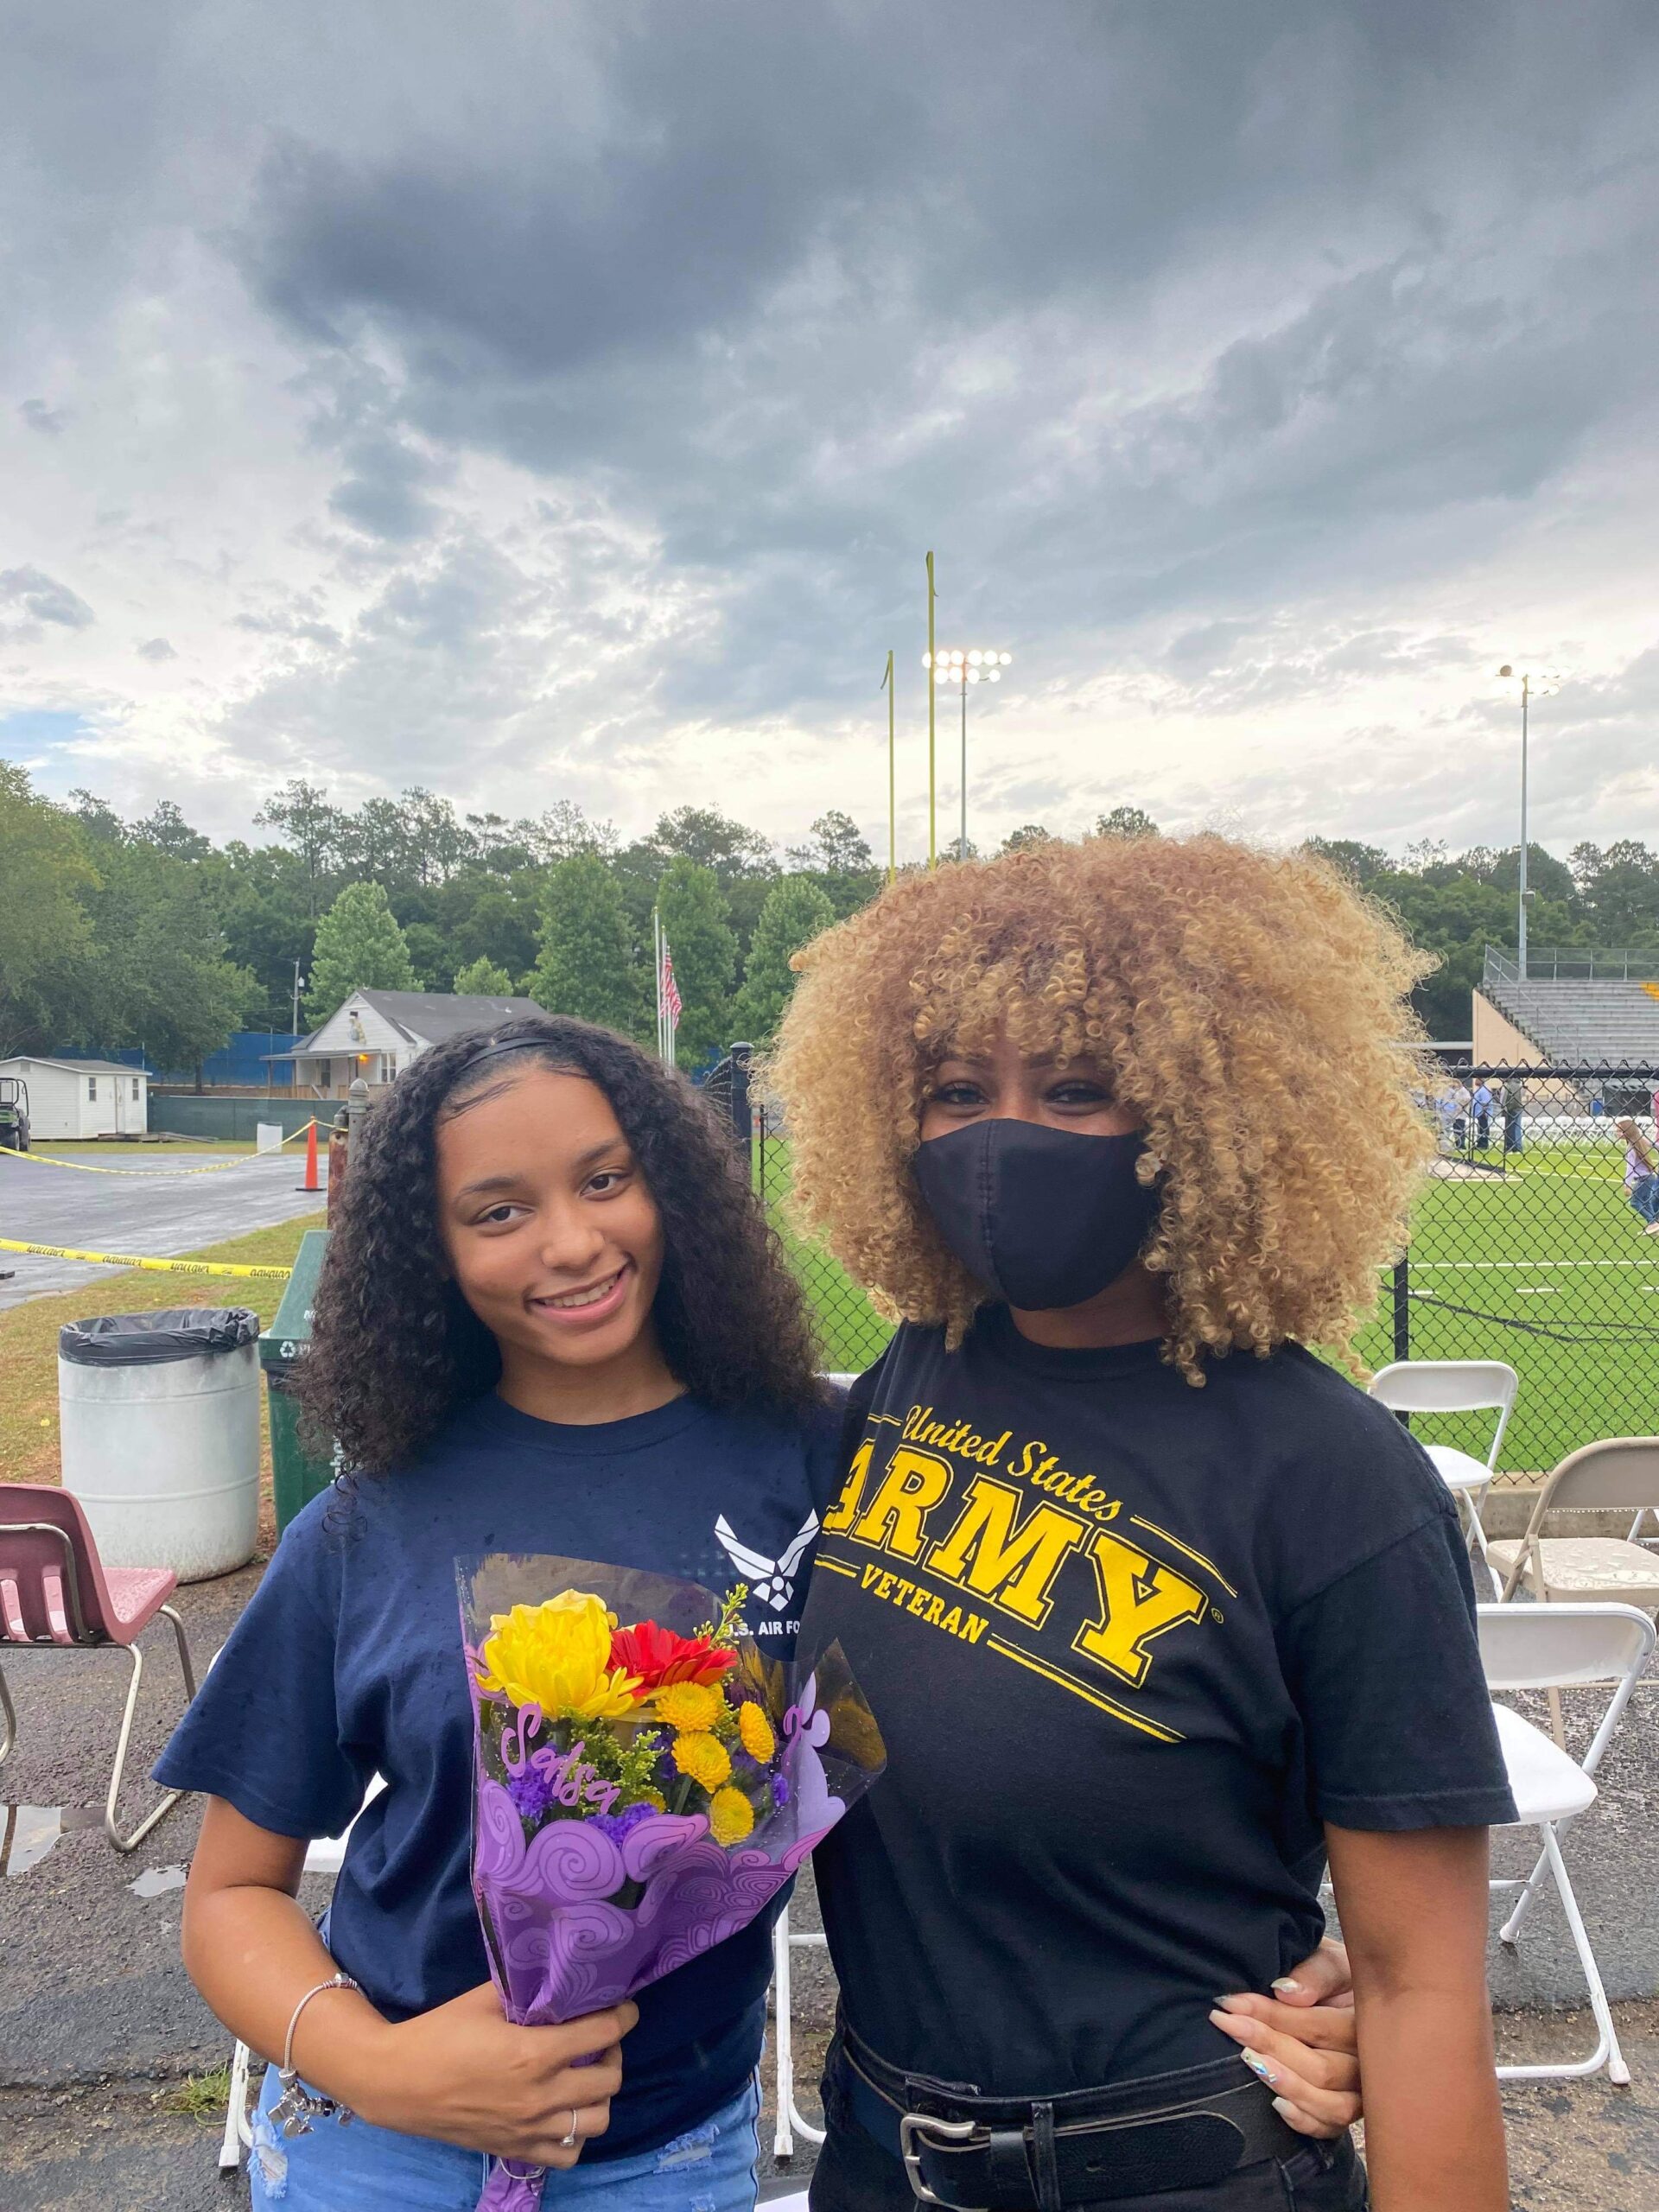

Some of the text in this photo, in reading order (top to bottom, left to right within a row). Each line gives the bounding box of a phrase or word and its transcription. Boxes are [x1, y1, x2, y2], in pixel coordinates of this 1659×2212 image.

[902, 1405, 1123, 1521] United States
[758, 1621, 784, 1635] AIR
[860, 1564, 988, 1644] VETERAN
